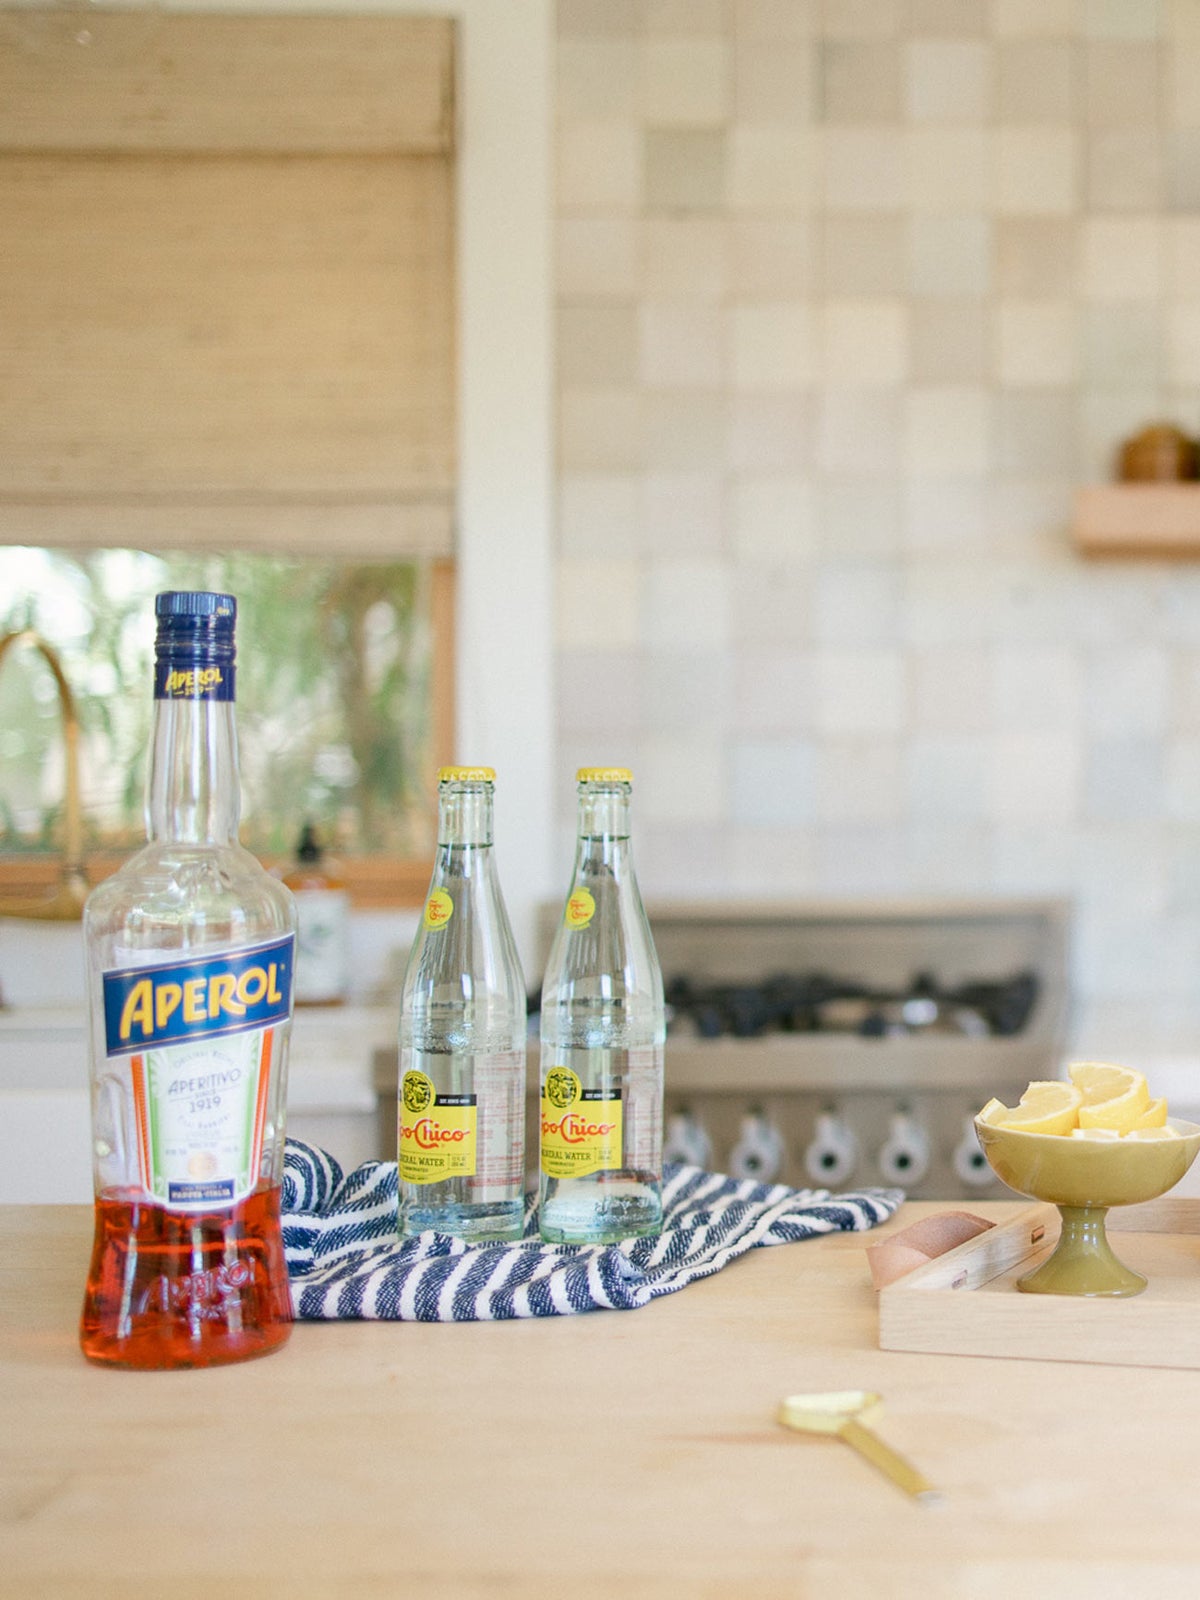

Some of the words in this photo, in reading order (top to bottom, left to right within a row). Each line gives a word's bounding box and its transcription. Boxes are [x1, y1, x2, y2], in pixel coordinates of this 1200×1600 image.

[165, 667, 224, 692] APEROL
[119, 962, 283, 1040] APEROL
[168, 1068, 242, 1096] APERITIVO
[189, 1096, 222, 1114] 1919
[414, 1118, 471, 1149] Chico
[541, 1112, 560, 1137] po
[560, 1113, 617, 1144] Chico
[418, 1157, 445, 1167] WATER
[564, 1151, 592, 1160] WATER
